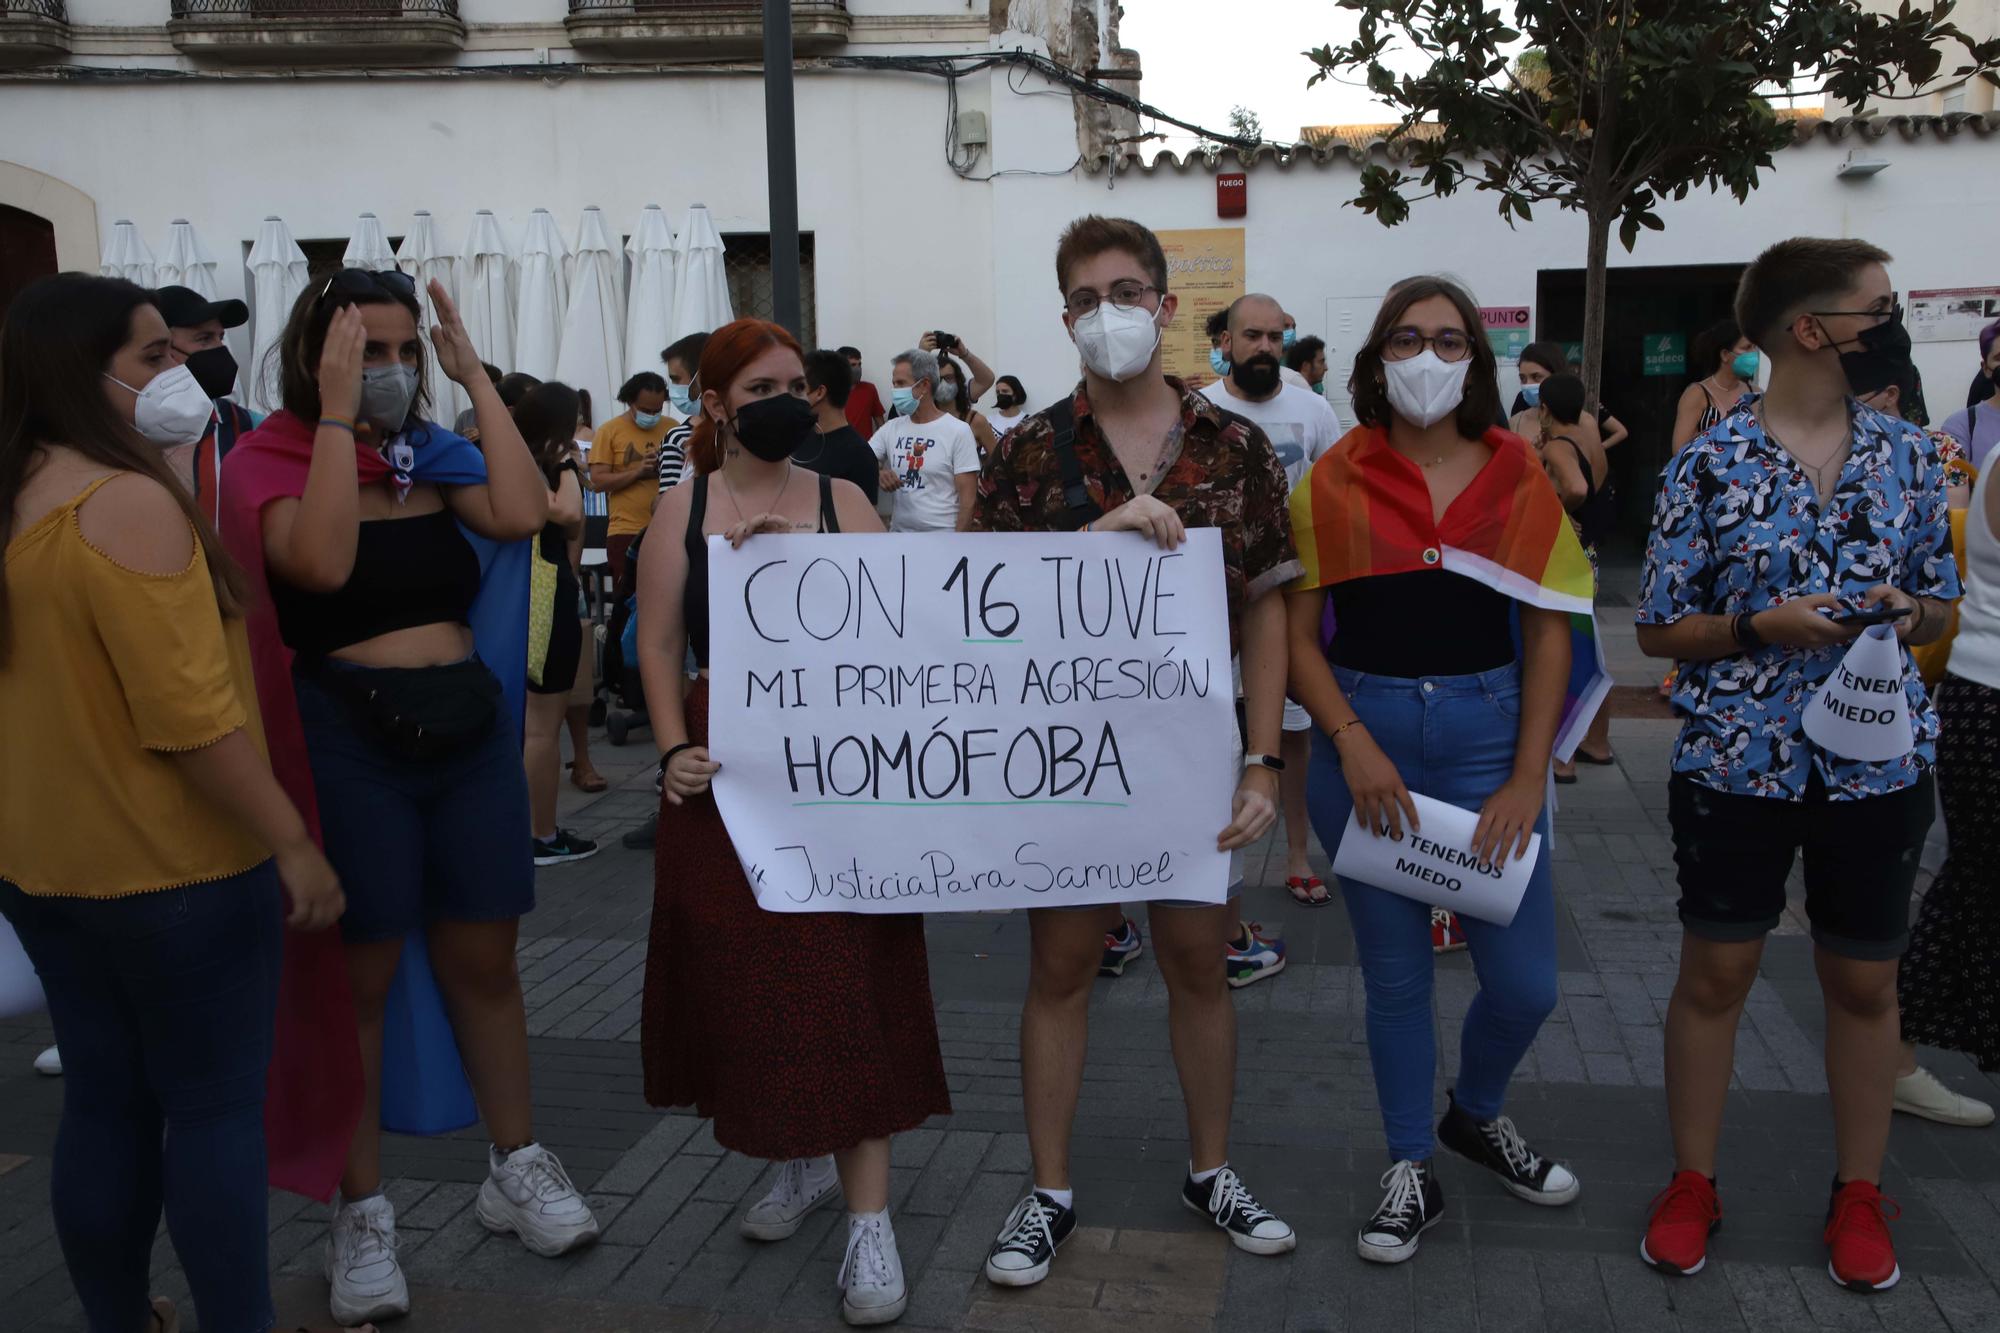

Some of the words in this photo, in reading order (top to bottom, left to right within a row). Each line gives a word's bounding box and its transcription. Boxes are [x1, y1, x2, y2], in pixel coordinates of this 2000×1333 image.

[1219, 179, 1244, 187] FUEGO
[1645, 353, 1685, 364] sadeco
[892, 454, 906, 468] IT
[895, 436, 936, 452] KEEP
[899, 474, 926, 490] EAL
[744, 554, 906, 643] CON
[941, 556, 1020, 638] 16
[1040, 553, 1188, 640] TUVE
[746, 669, 809, 709] MI
[834, 662, 998, 709] PRIMERA
[1020, 645, 1210, 706] AGRESIÓN
[1823, 690, 1896, 725] MIEDO
[783, 716, 1132, 800] HOMÓFOBA
[1410, 834, 1504, 879] TENEMOS
[1395, 857, 1462, 892] MIEDO
